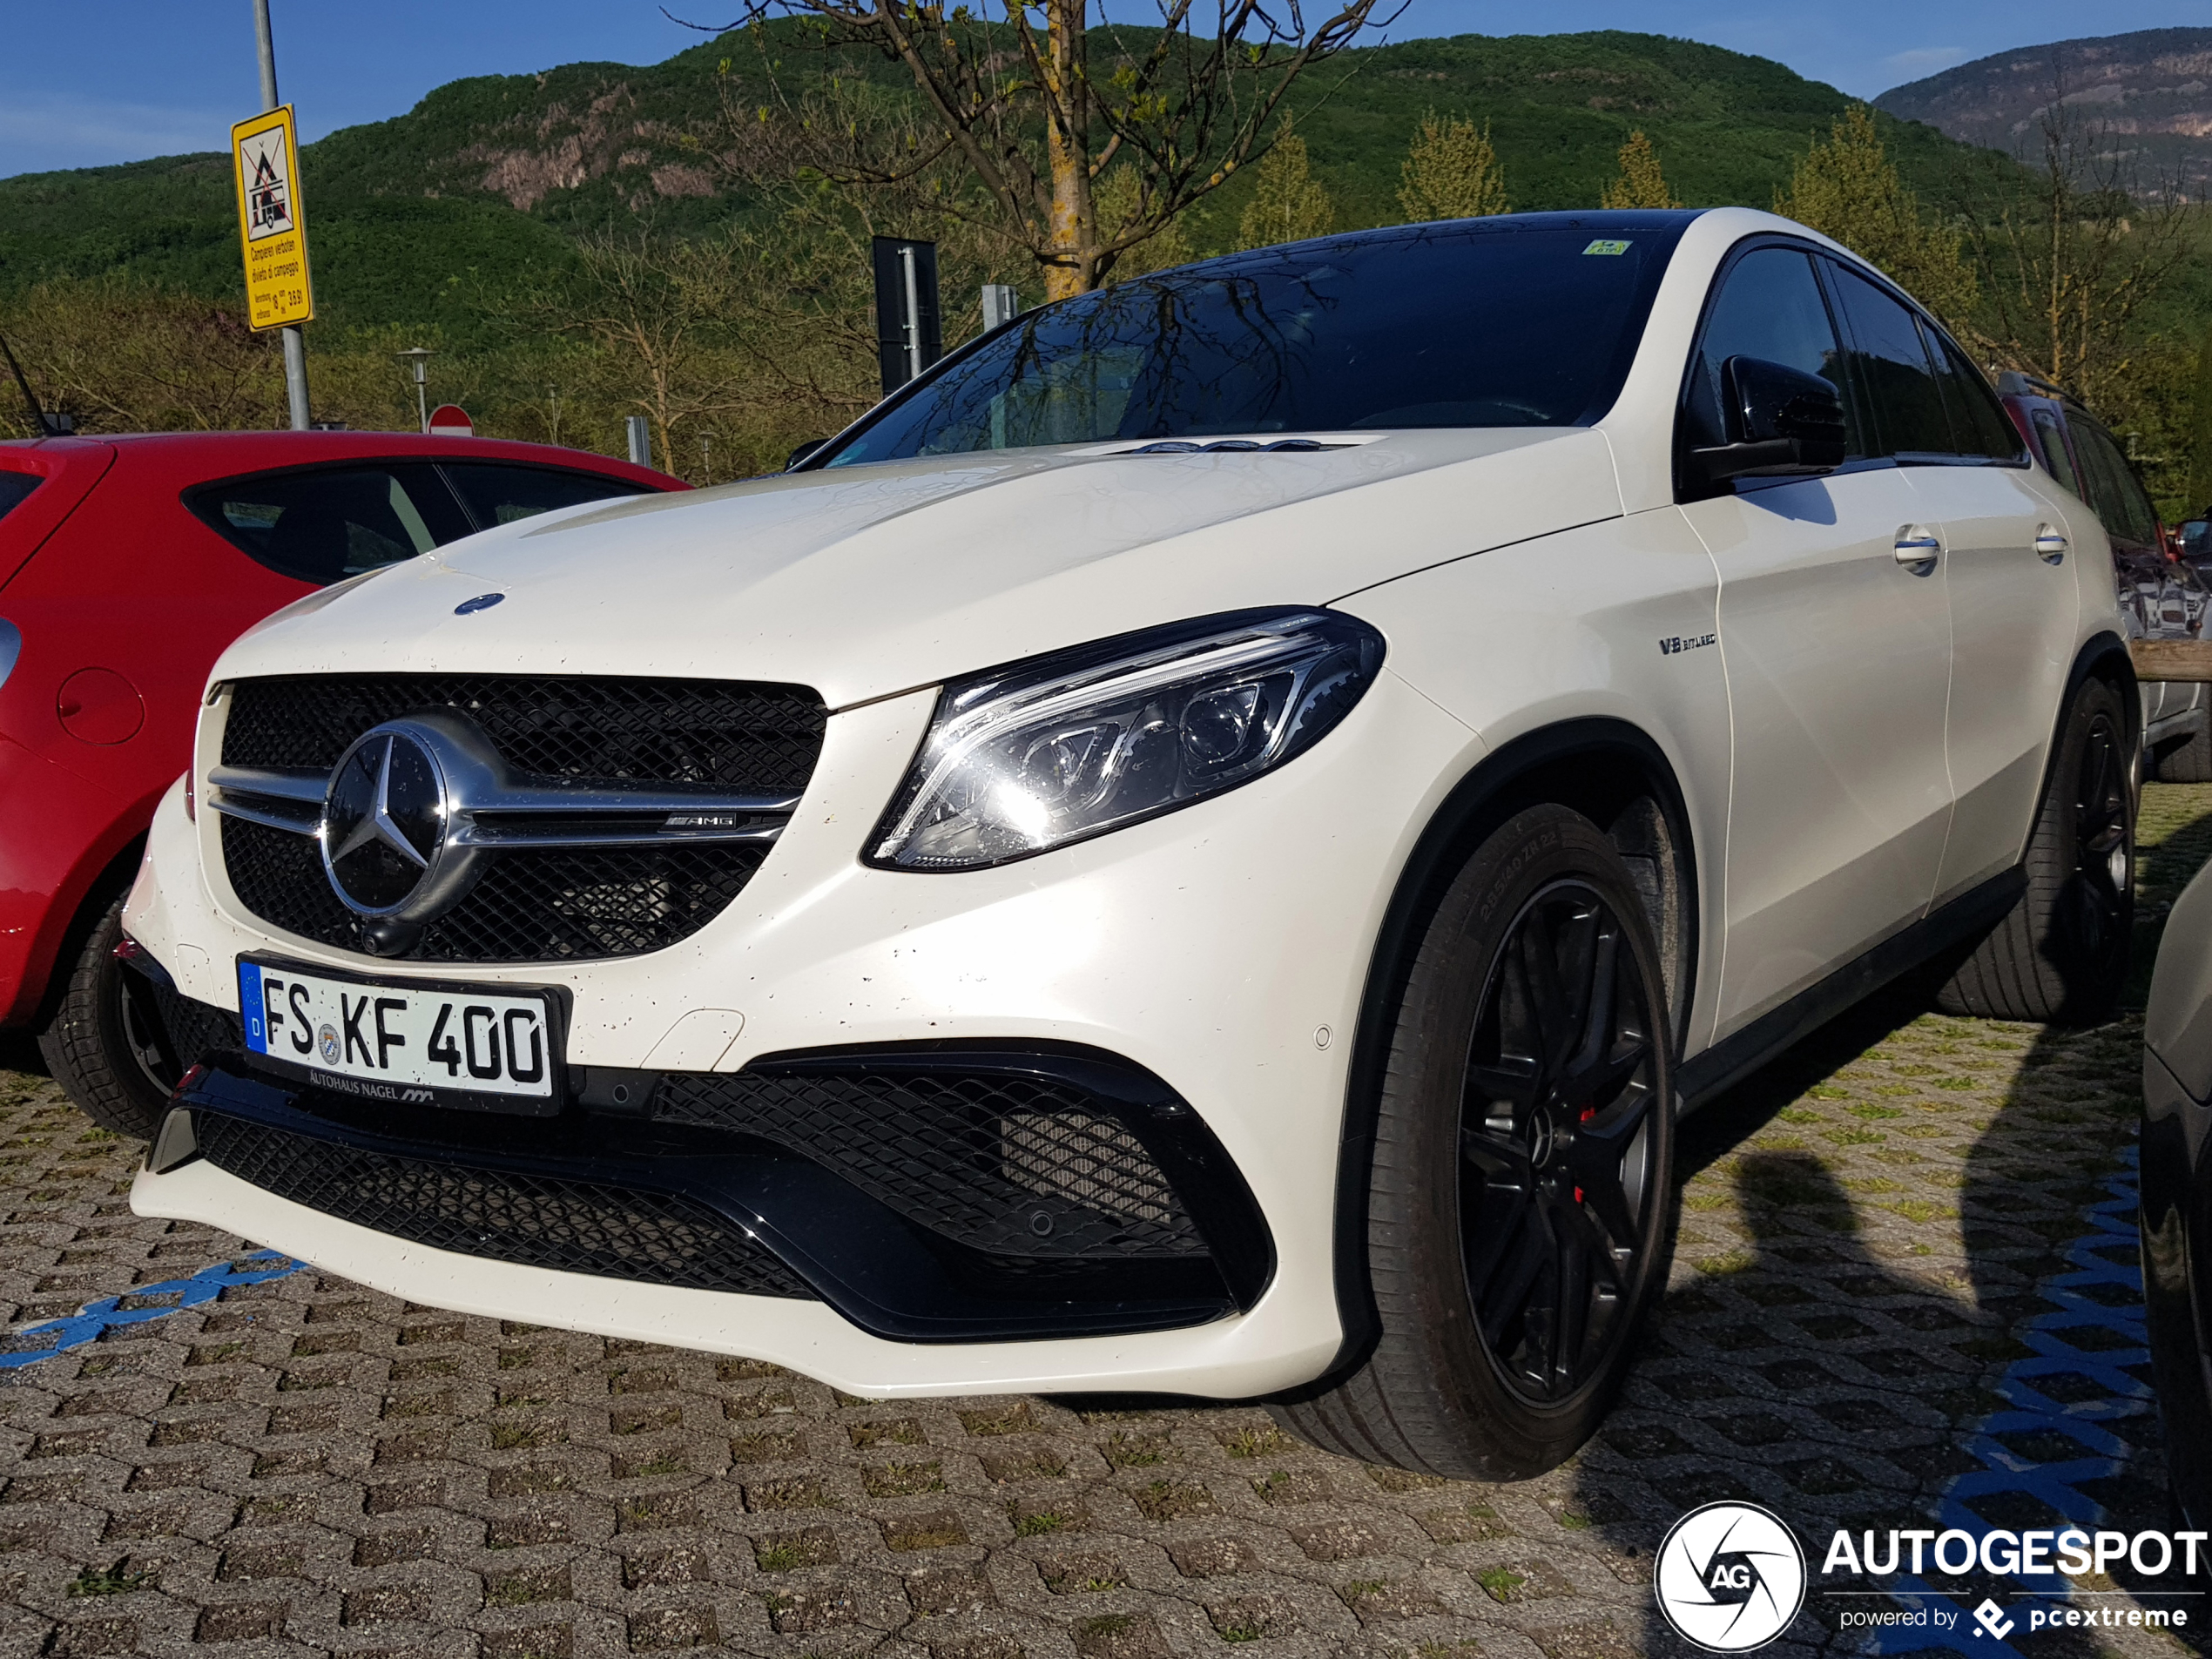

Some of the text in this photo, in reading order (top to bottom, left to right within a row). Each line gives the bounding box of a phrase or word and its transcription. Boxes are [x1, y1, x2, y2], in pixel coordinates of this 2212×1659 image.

[251, 239, 295, 262] Campieren verboten
[252, 259, 299, 283] divieto di campeggio
[1659, 637, 1681, 655] V8
[686, 817, 733, 826] AMG
[1540, 831, 1558, 848] 22
[252, 1017, 260, 1036] D
[264, 977, 314, 1055] FS
[341, 992, 408, 1069] KF
[428, 1003, 543, 1083] 400
[310, 1070, 398, 1100] AUTOHAUS NAGEL
